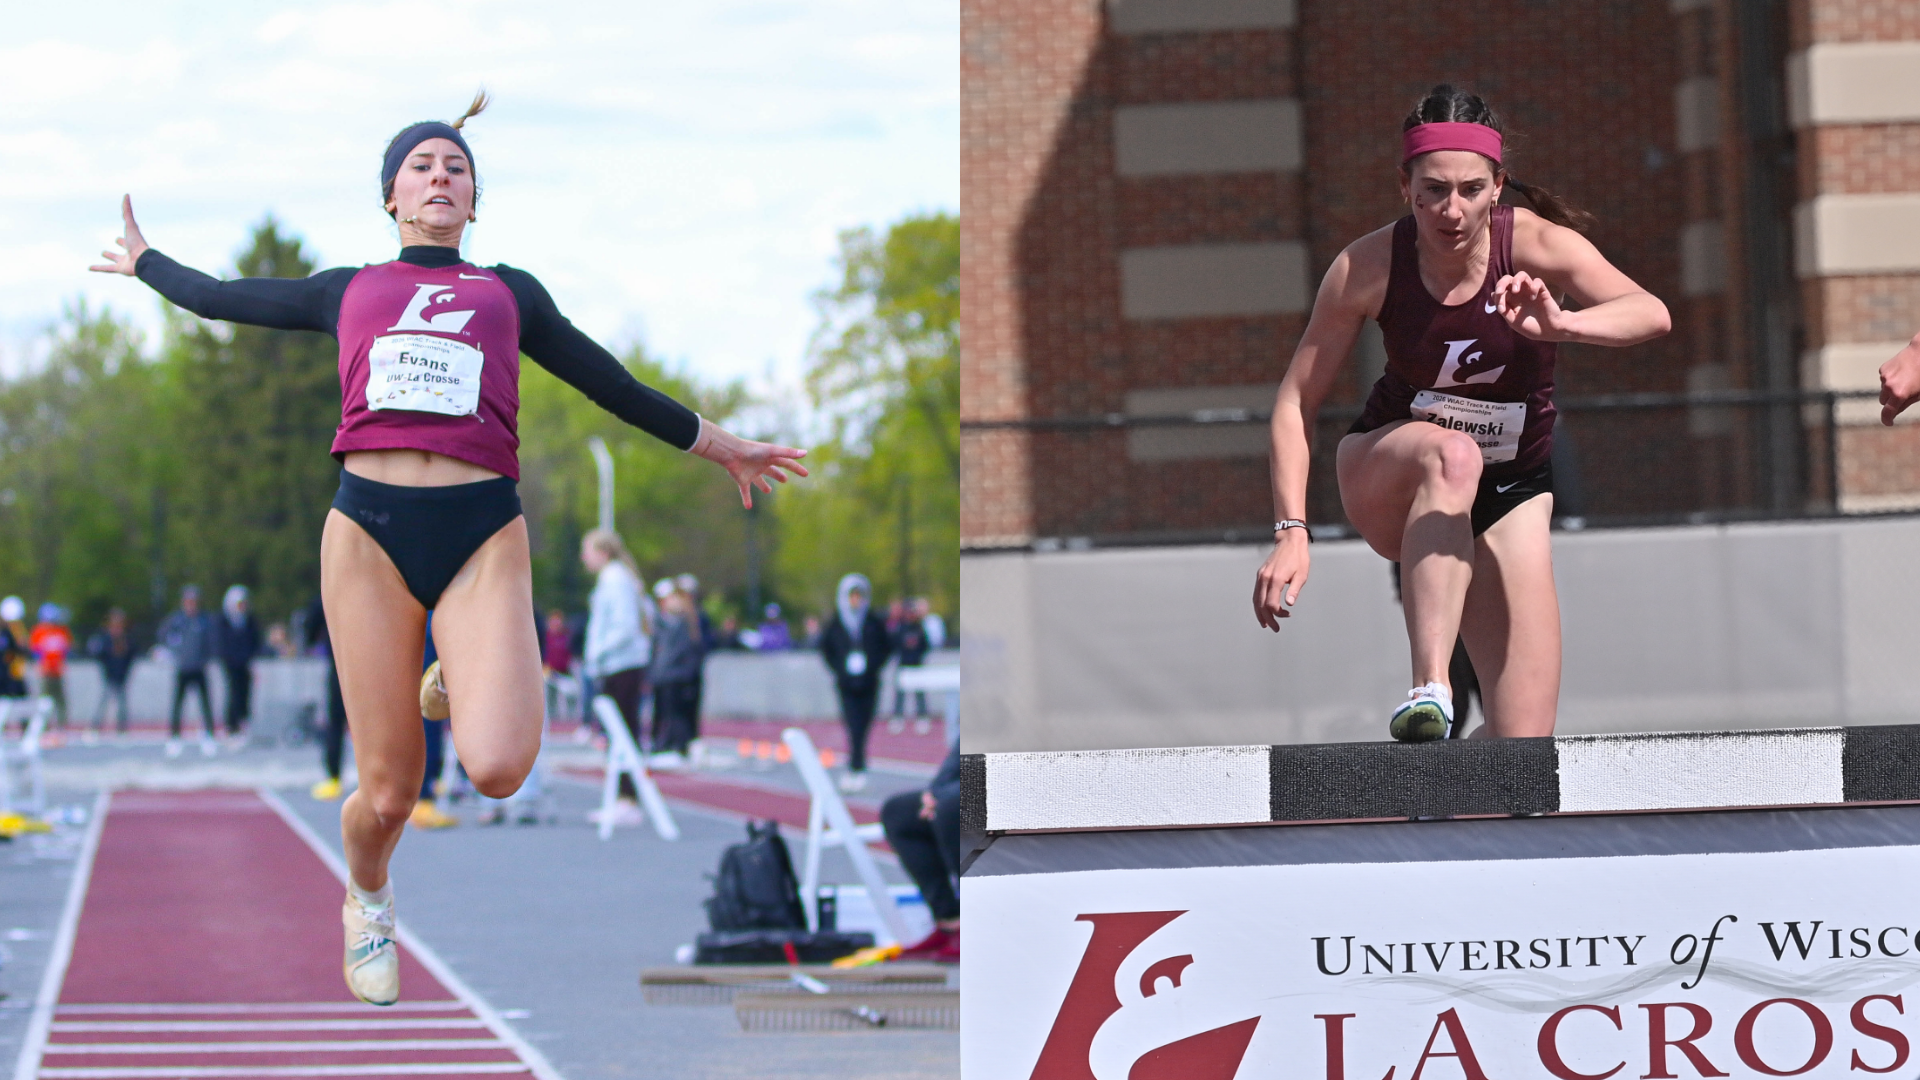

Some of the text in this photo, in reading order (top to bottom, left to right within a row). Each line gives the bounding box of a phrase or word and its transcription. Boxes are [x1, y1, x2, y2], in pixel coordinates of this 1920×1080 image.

[450, 343, 465, 351] Field
[399, 351, 448, 372] Evans
[386, 372, 460, 385] UW-La Crosse
[1443, 403, 1492, 416] Championships
[1447, 397, 1465, 406] WIAC
[1466, 401, 1484, 409] Track
[1427, 412, 1504, 436] Zalewski
[1310, 914, 1920, 990] UNIVERSITY of WISC
[1313, 994, 1910, 1080] LA CROS
